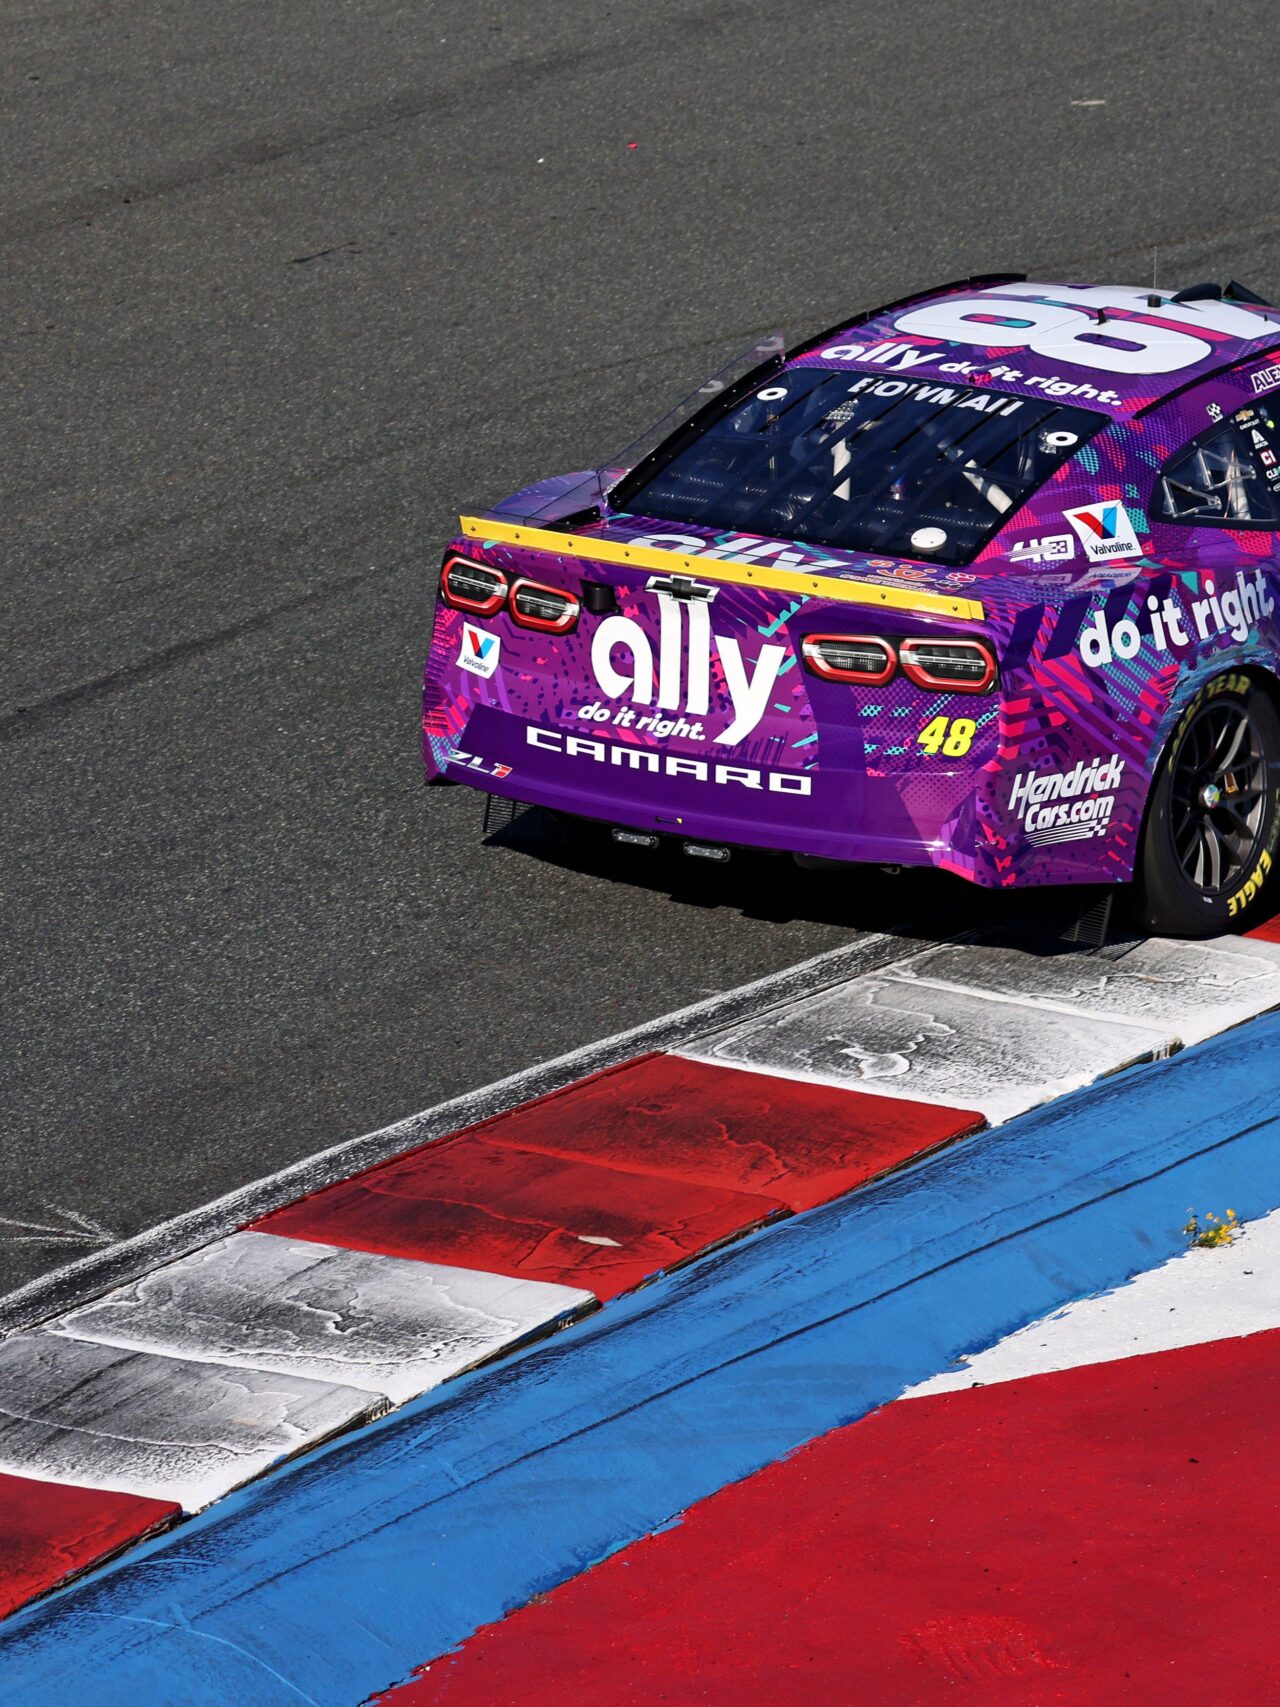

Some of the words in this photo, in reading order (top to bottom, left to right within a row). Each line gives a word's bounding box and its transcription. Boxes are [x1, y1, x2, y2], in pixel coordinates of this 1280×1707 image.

[820, 342, 948, 372] ally
[1023, 375, 1123, 406] right.
[1090, 541, 1133, 555] Valvoline
[1079, 610, 1141, 668] do
[1147, 594, 1188, 651] it
[1192, 569, 1274, 641] right.
[463, 655, 489, 673] Valvoline
[590, 593, 786, 746] ally
[578, 702, 609, 721] do
[612, 706, 634, 728] it
[636, 716, 706, 741] right.
[917, 716, 977, 758] 48
[527, 726, 811, 796] CAMARO
[1008, 754, 1125, 819] Hendrick
[1024, 795, 1115, 832] Cars.com
[1227, 848, 1272, 917] EAGLE
